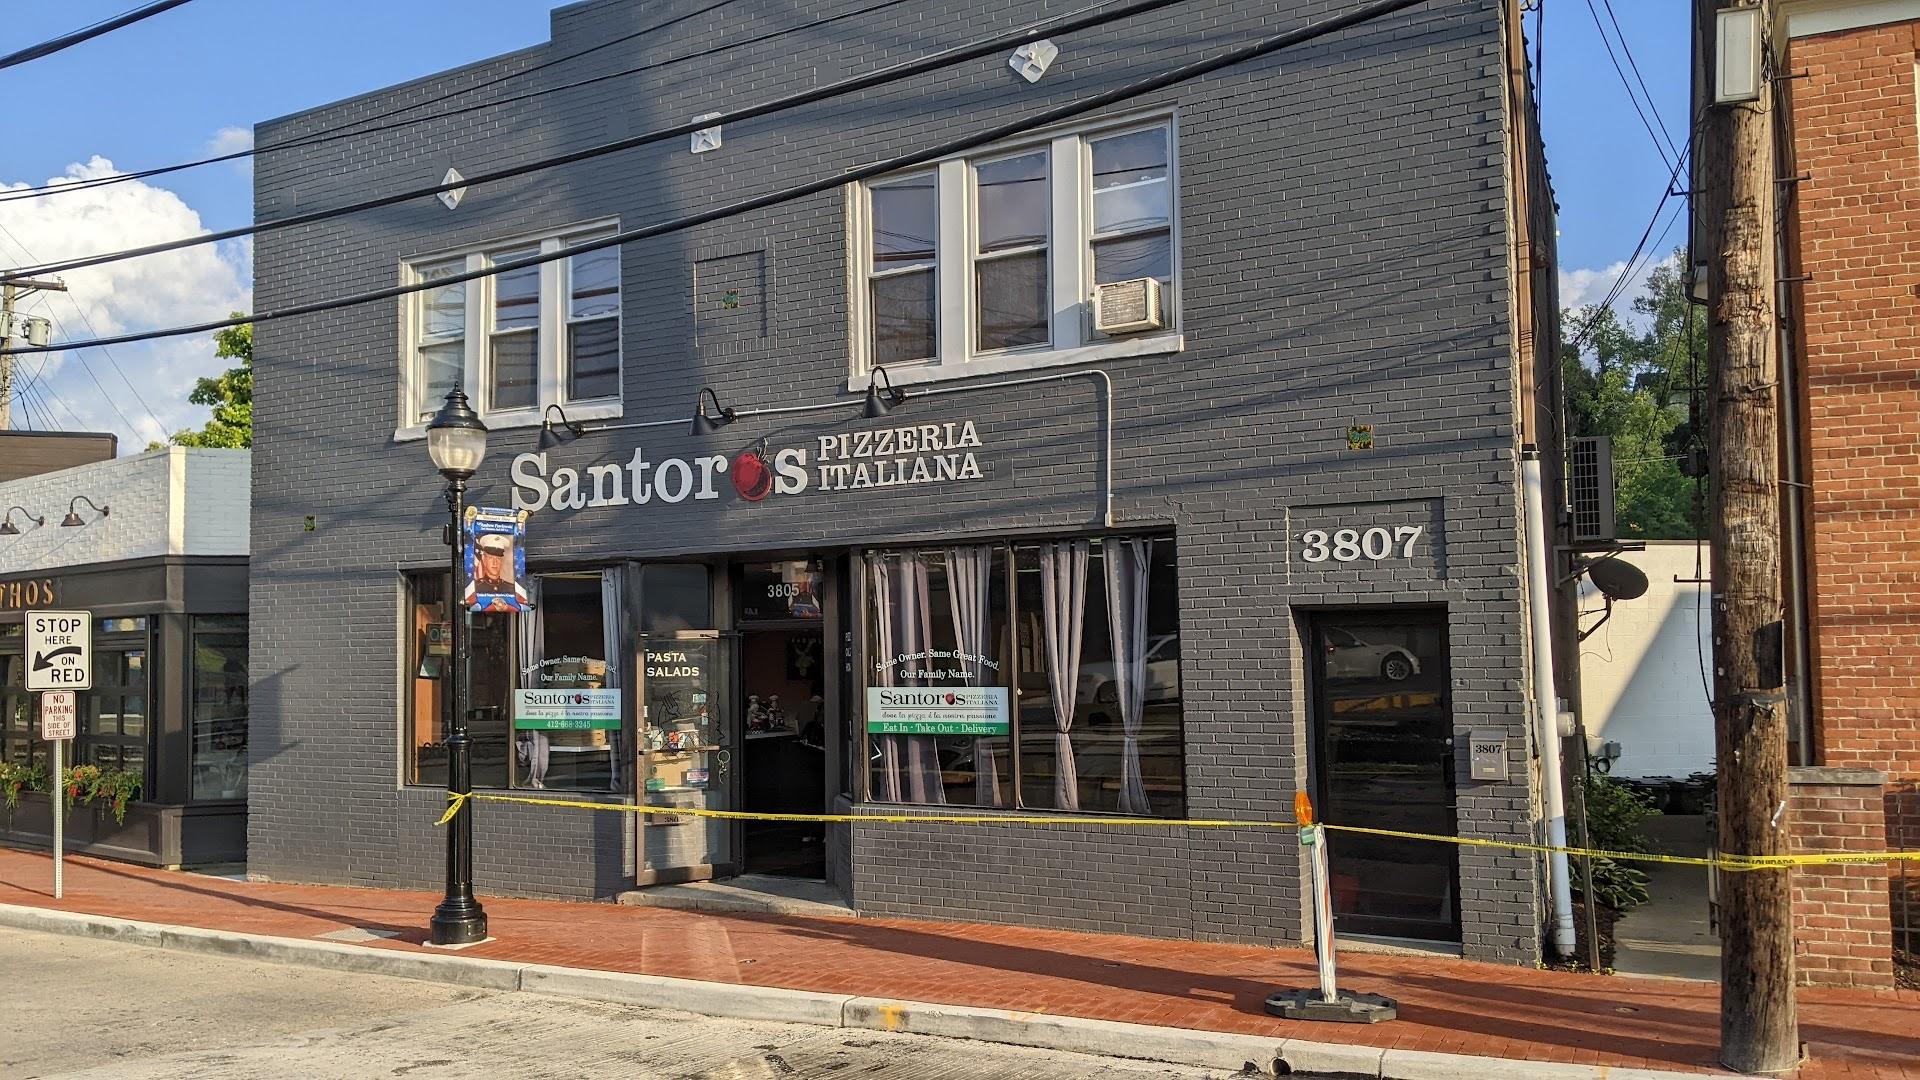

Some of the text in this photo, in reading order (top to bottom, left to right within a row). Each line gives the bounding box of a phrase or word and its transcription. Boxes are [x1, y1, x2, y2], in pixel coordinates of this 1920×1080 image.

[817, 420, 983, 462] PIZZERIA
[817, 452, 984, 491] ITALIANA
[1302, 525, 1423, 562] 3807
[767, 583, 800, 598] 3805
[36, 618, 81, 633] STOP
[45, 635, 72, 645] HERE
[61, 656, 75, 666] ON
[646, 652, 687, 663] PASTA
[875, 648, 1000, 673] Same Owner. Same Great Food.
[522, 663, 540, 676] Same
[563, 654, 581, 664] Same
[51, 668, 85, 683] RED
[540, 672, 599, 683] Our Family Name.
[646, 666, 700, 677] SALADS
[900, 669, 975, 681] Our Family Name.
[53, 695, 65, 704] NO
[45, 705, 73, 715] PARKING
[48, 729, 71, 737] STREET
[882, 723, 998, 735] Eat In Take Out Delivery
[1475, 744, 1503, 754] 3807
